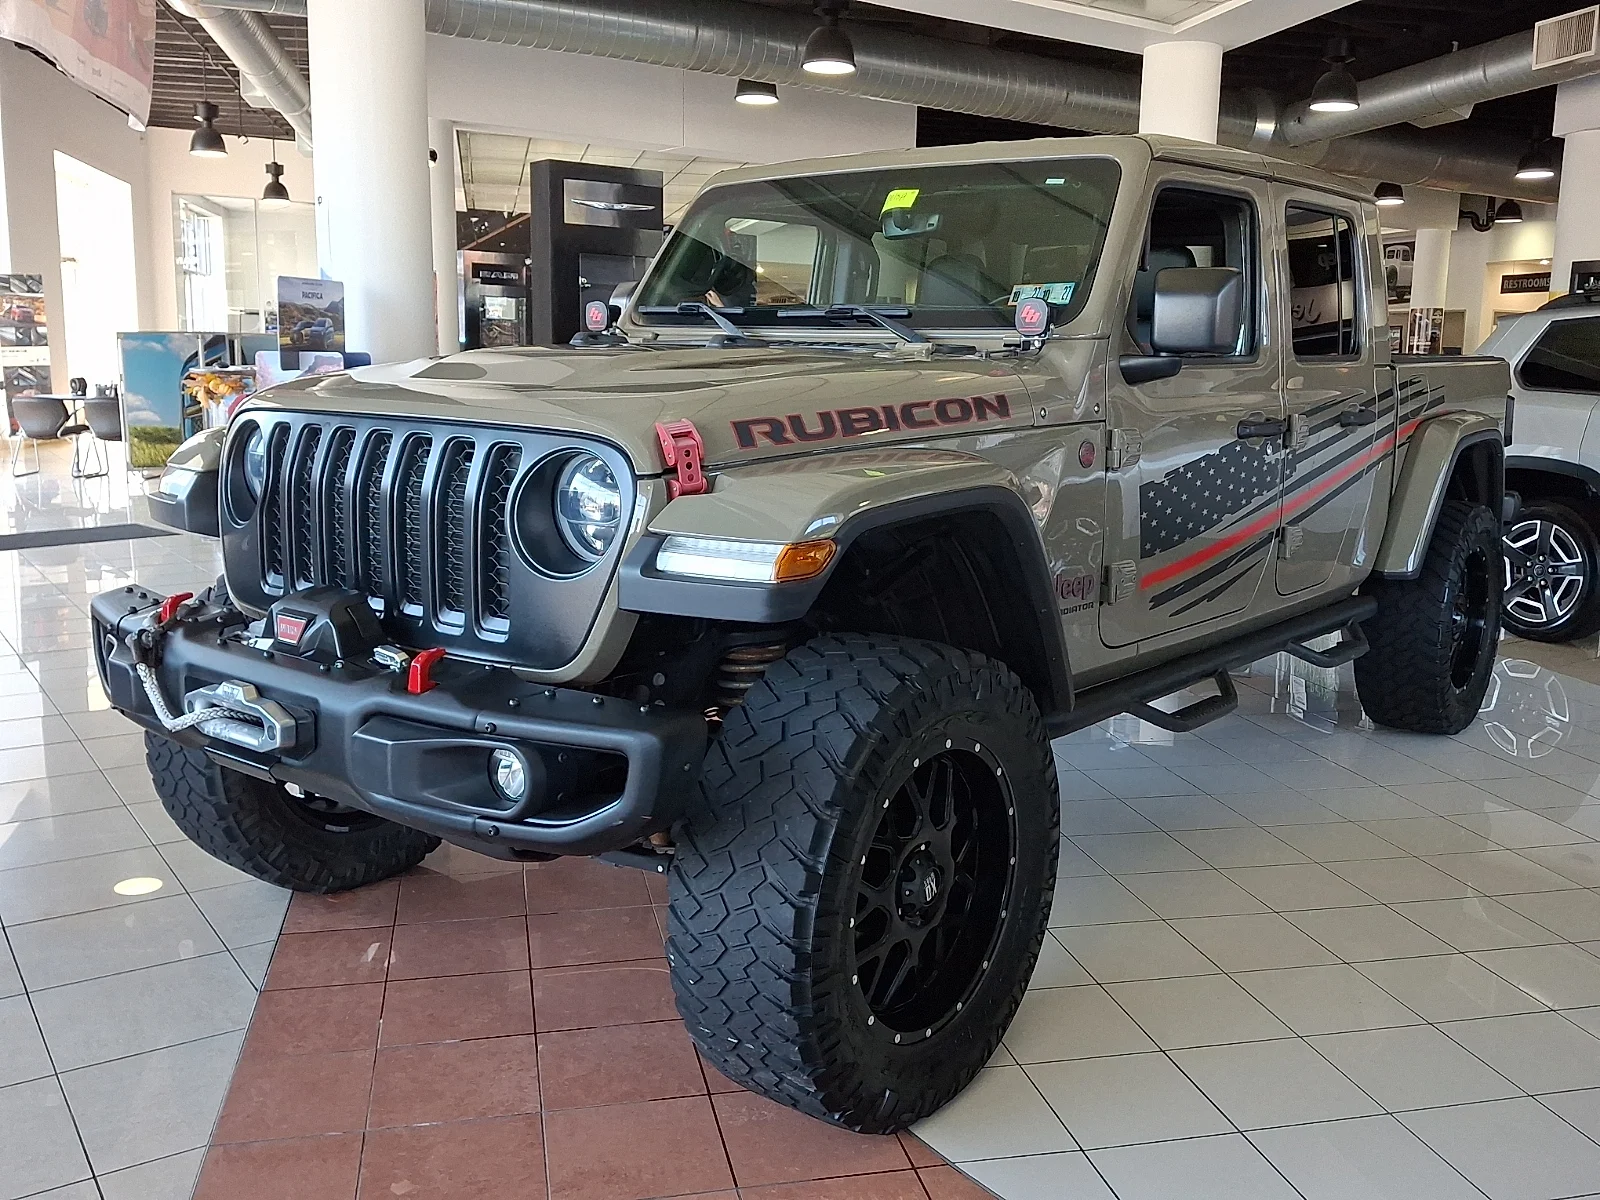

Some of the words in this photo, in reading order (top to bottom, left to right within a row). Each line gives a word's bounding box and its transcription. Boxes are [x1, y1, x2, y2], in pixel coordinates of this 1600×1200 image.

[301, 291, 324, 300] PACIFICA
[1061, 285, 1072, 301] 27
[729, 393, 1012, 450] RUBICON
[1055, 573, 1095, 601] Jeep
[1060, 601, 1095, 616] DIATOR
